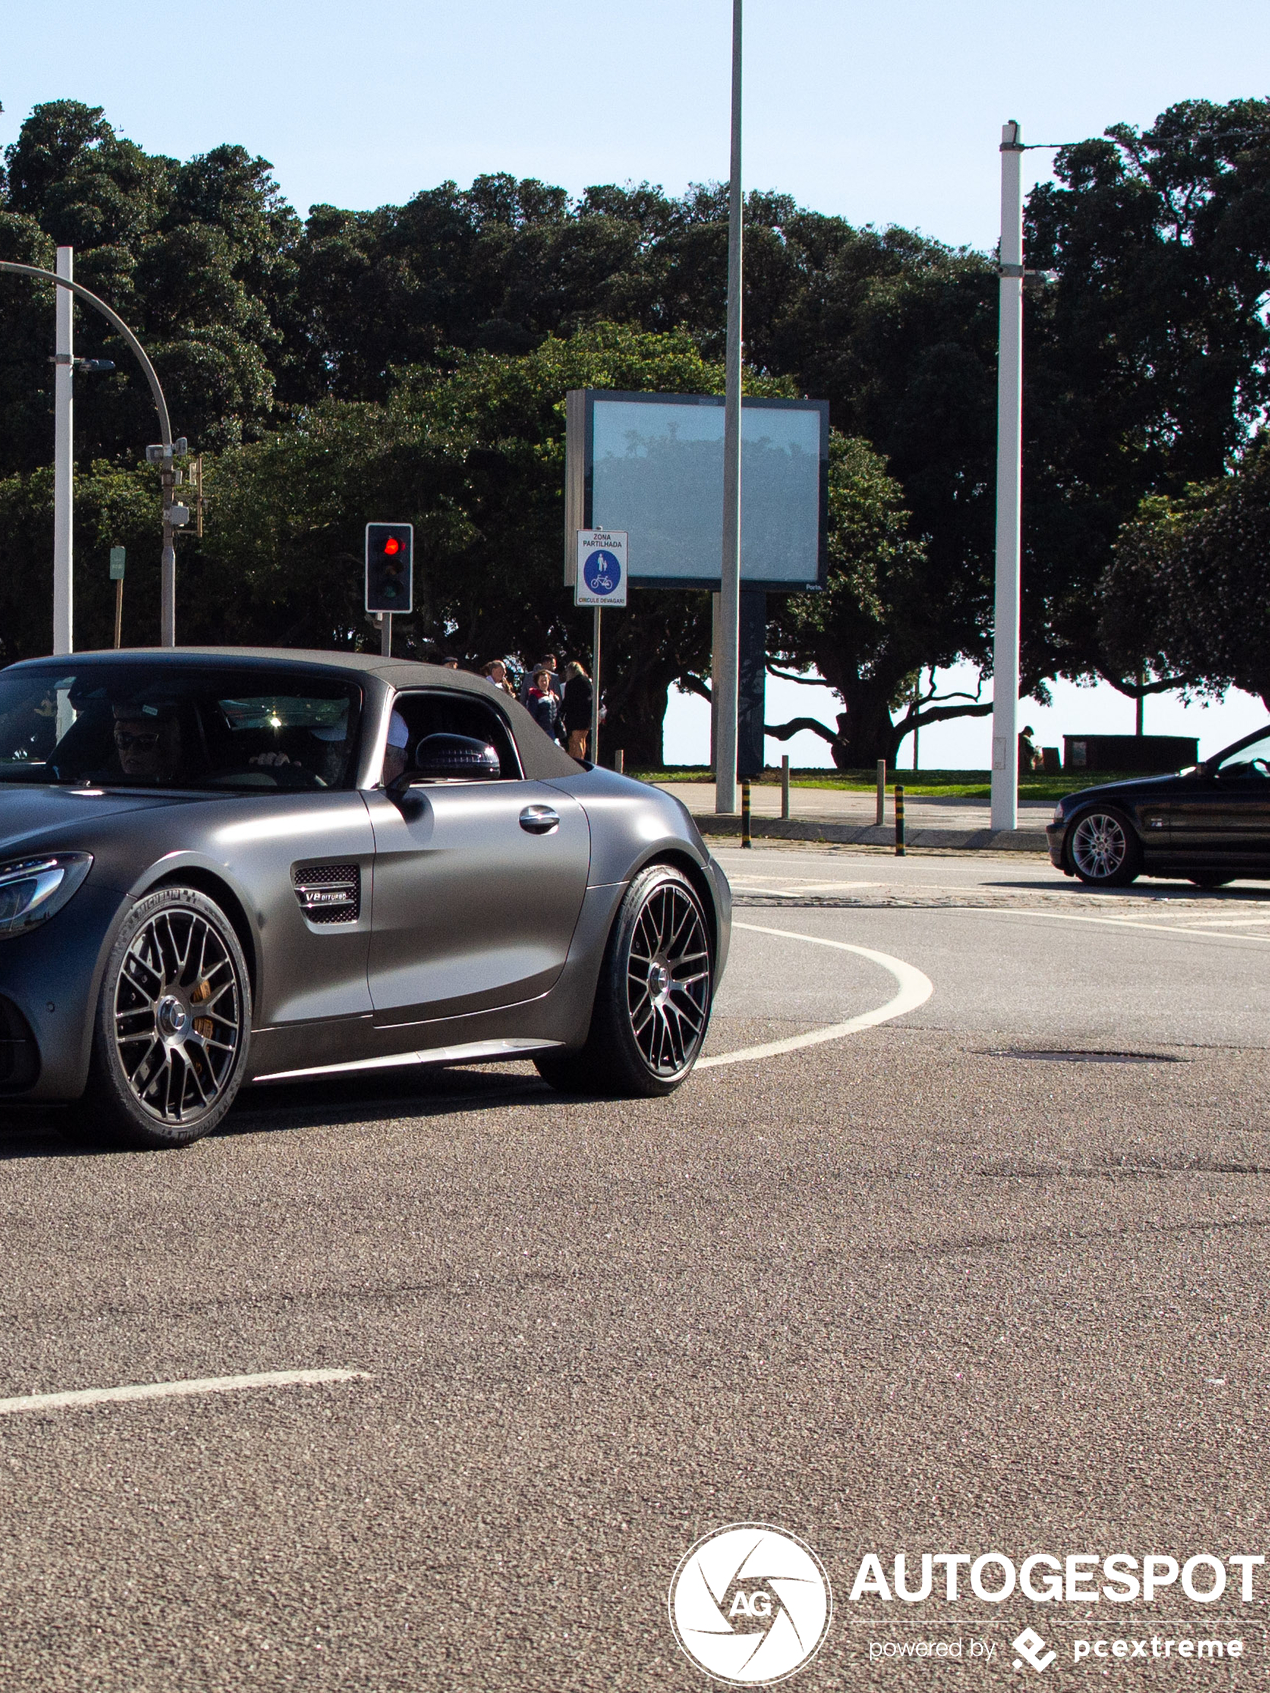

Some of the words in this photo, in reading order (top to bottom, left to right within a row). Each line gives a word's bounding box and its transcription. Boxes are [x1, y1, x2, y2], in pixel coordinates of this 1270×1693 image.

[593, 533, 611, 541] ZONA
[582, 540, 622, 548] PARTILHADA
[305, 892, 321, 901] V8
